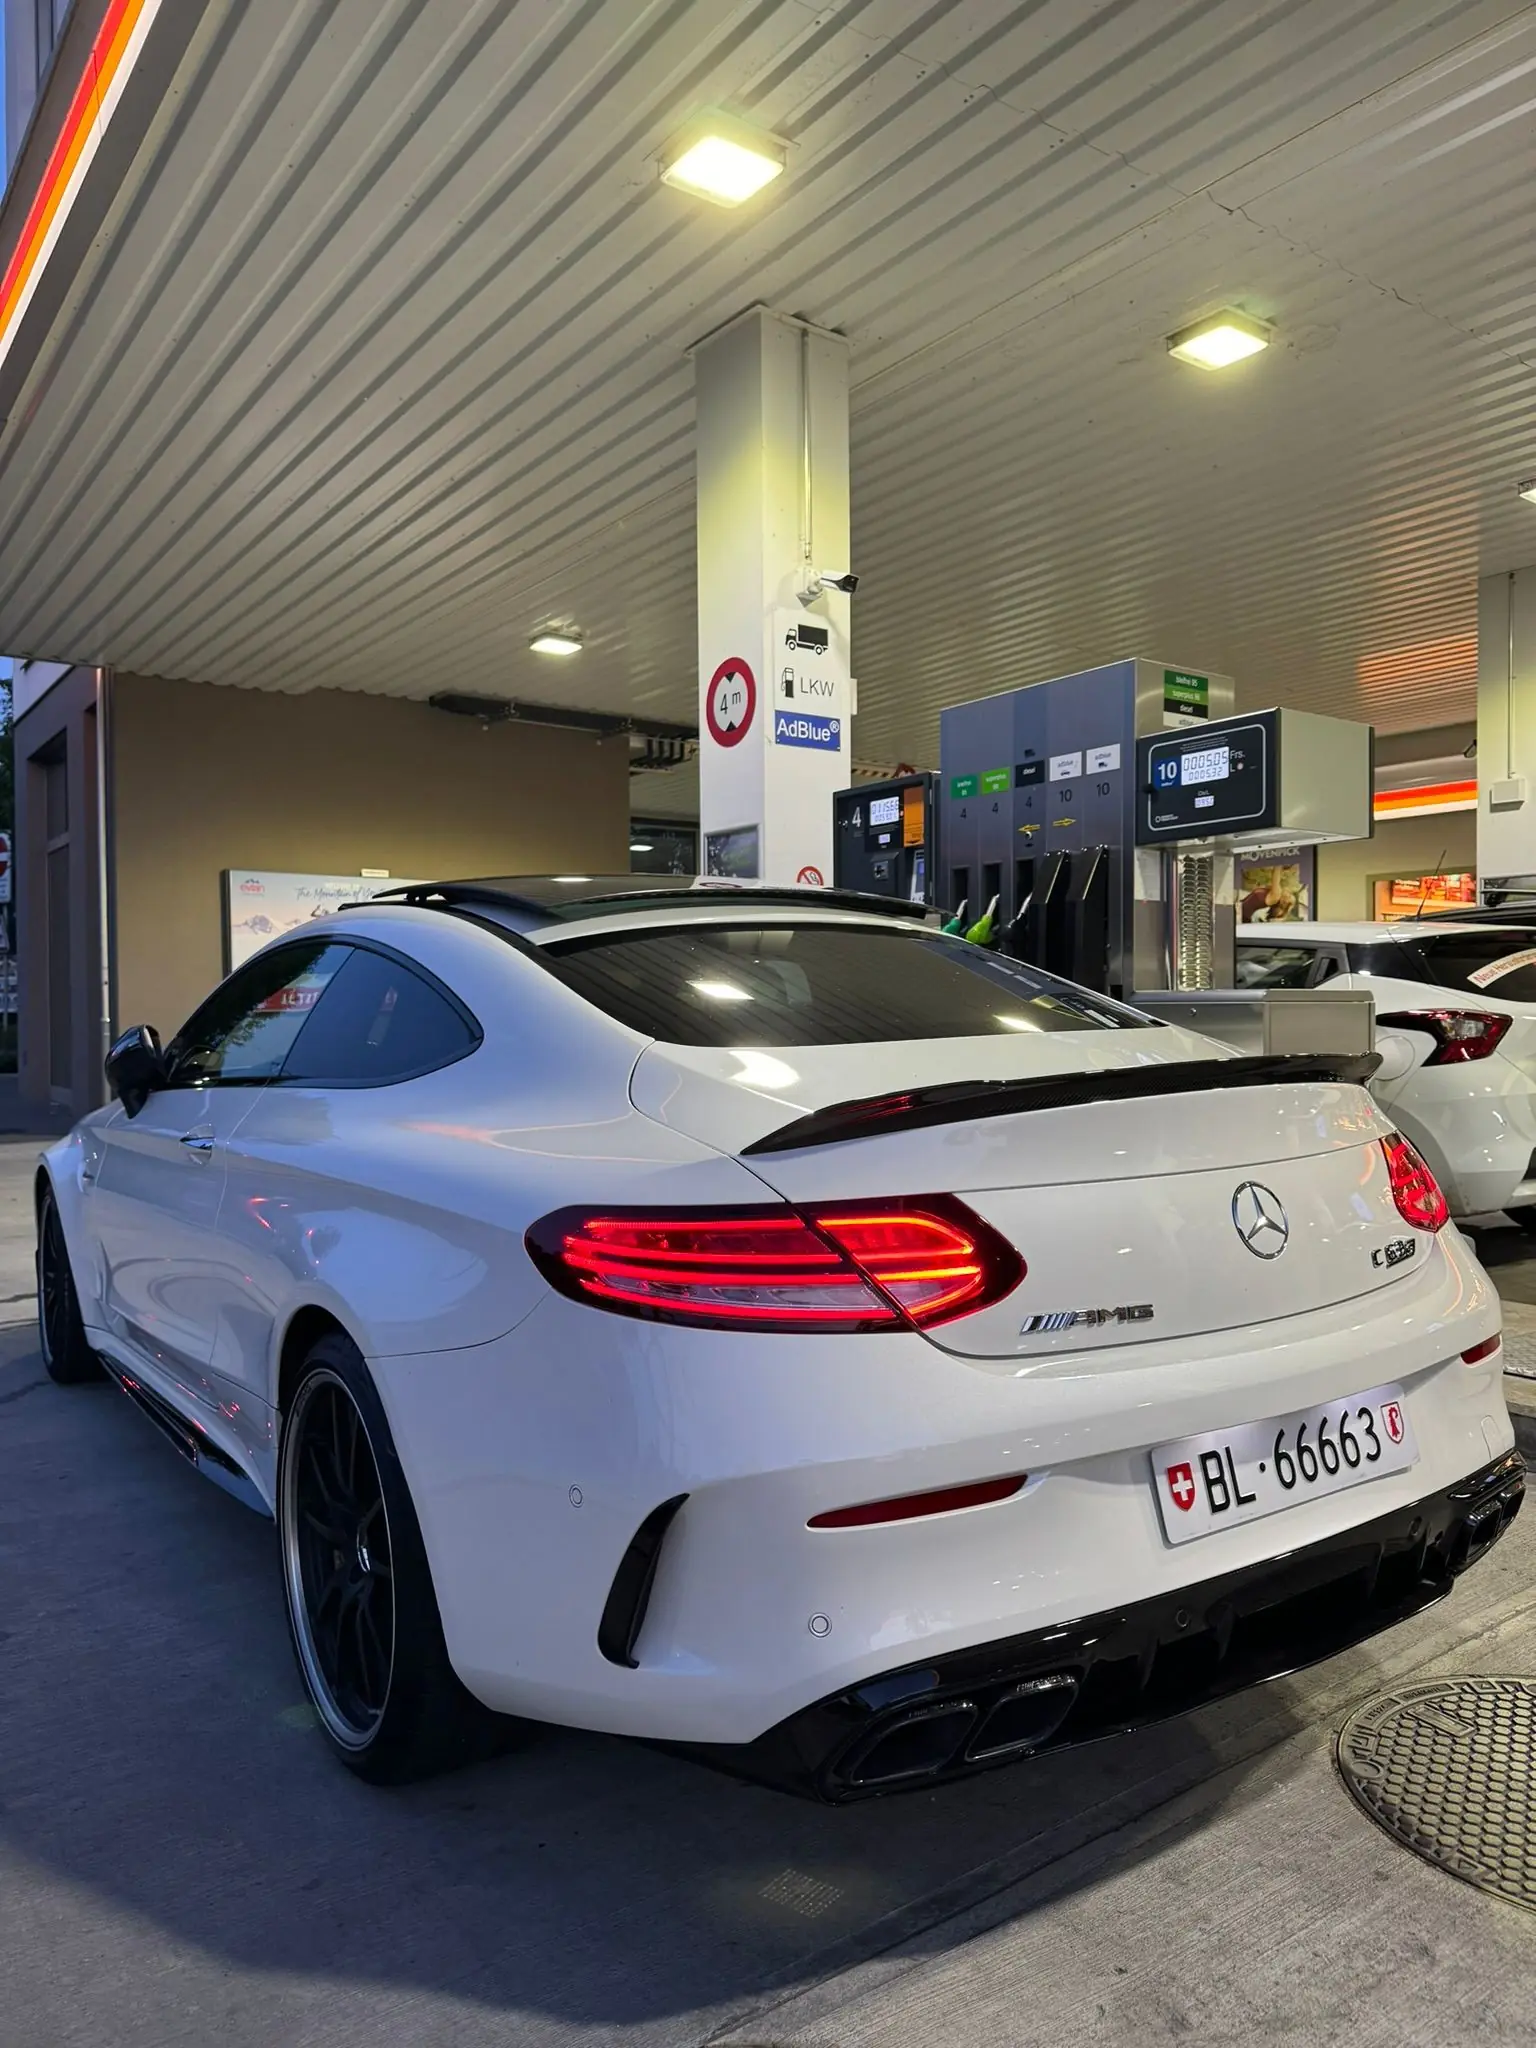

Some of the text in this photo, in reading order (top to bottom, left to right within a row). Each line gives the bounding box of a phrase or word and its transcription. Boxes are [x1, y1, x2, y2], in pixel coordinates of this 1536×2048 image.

[800, 676, 834, 698] LKW
[719, 691, 742, 715] 4 m
[1157, 761, 1178, 781] 10
[1059, 788, 1073, 803] 10
[1096, 782, 1111, 797] 10
[992, 802, 999, 815] 4
[1025, 796, 1033, 809] 4
[851, 806, 862, 828] 4
[960, 808, 967, 820] 4
[295, 886, 312, 901] The
[313, 887, 351, 901] Mountain
[1198, 1406, 1381, 1514] BL 66663
